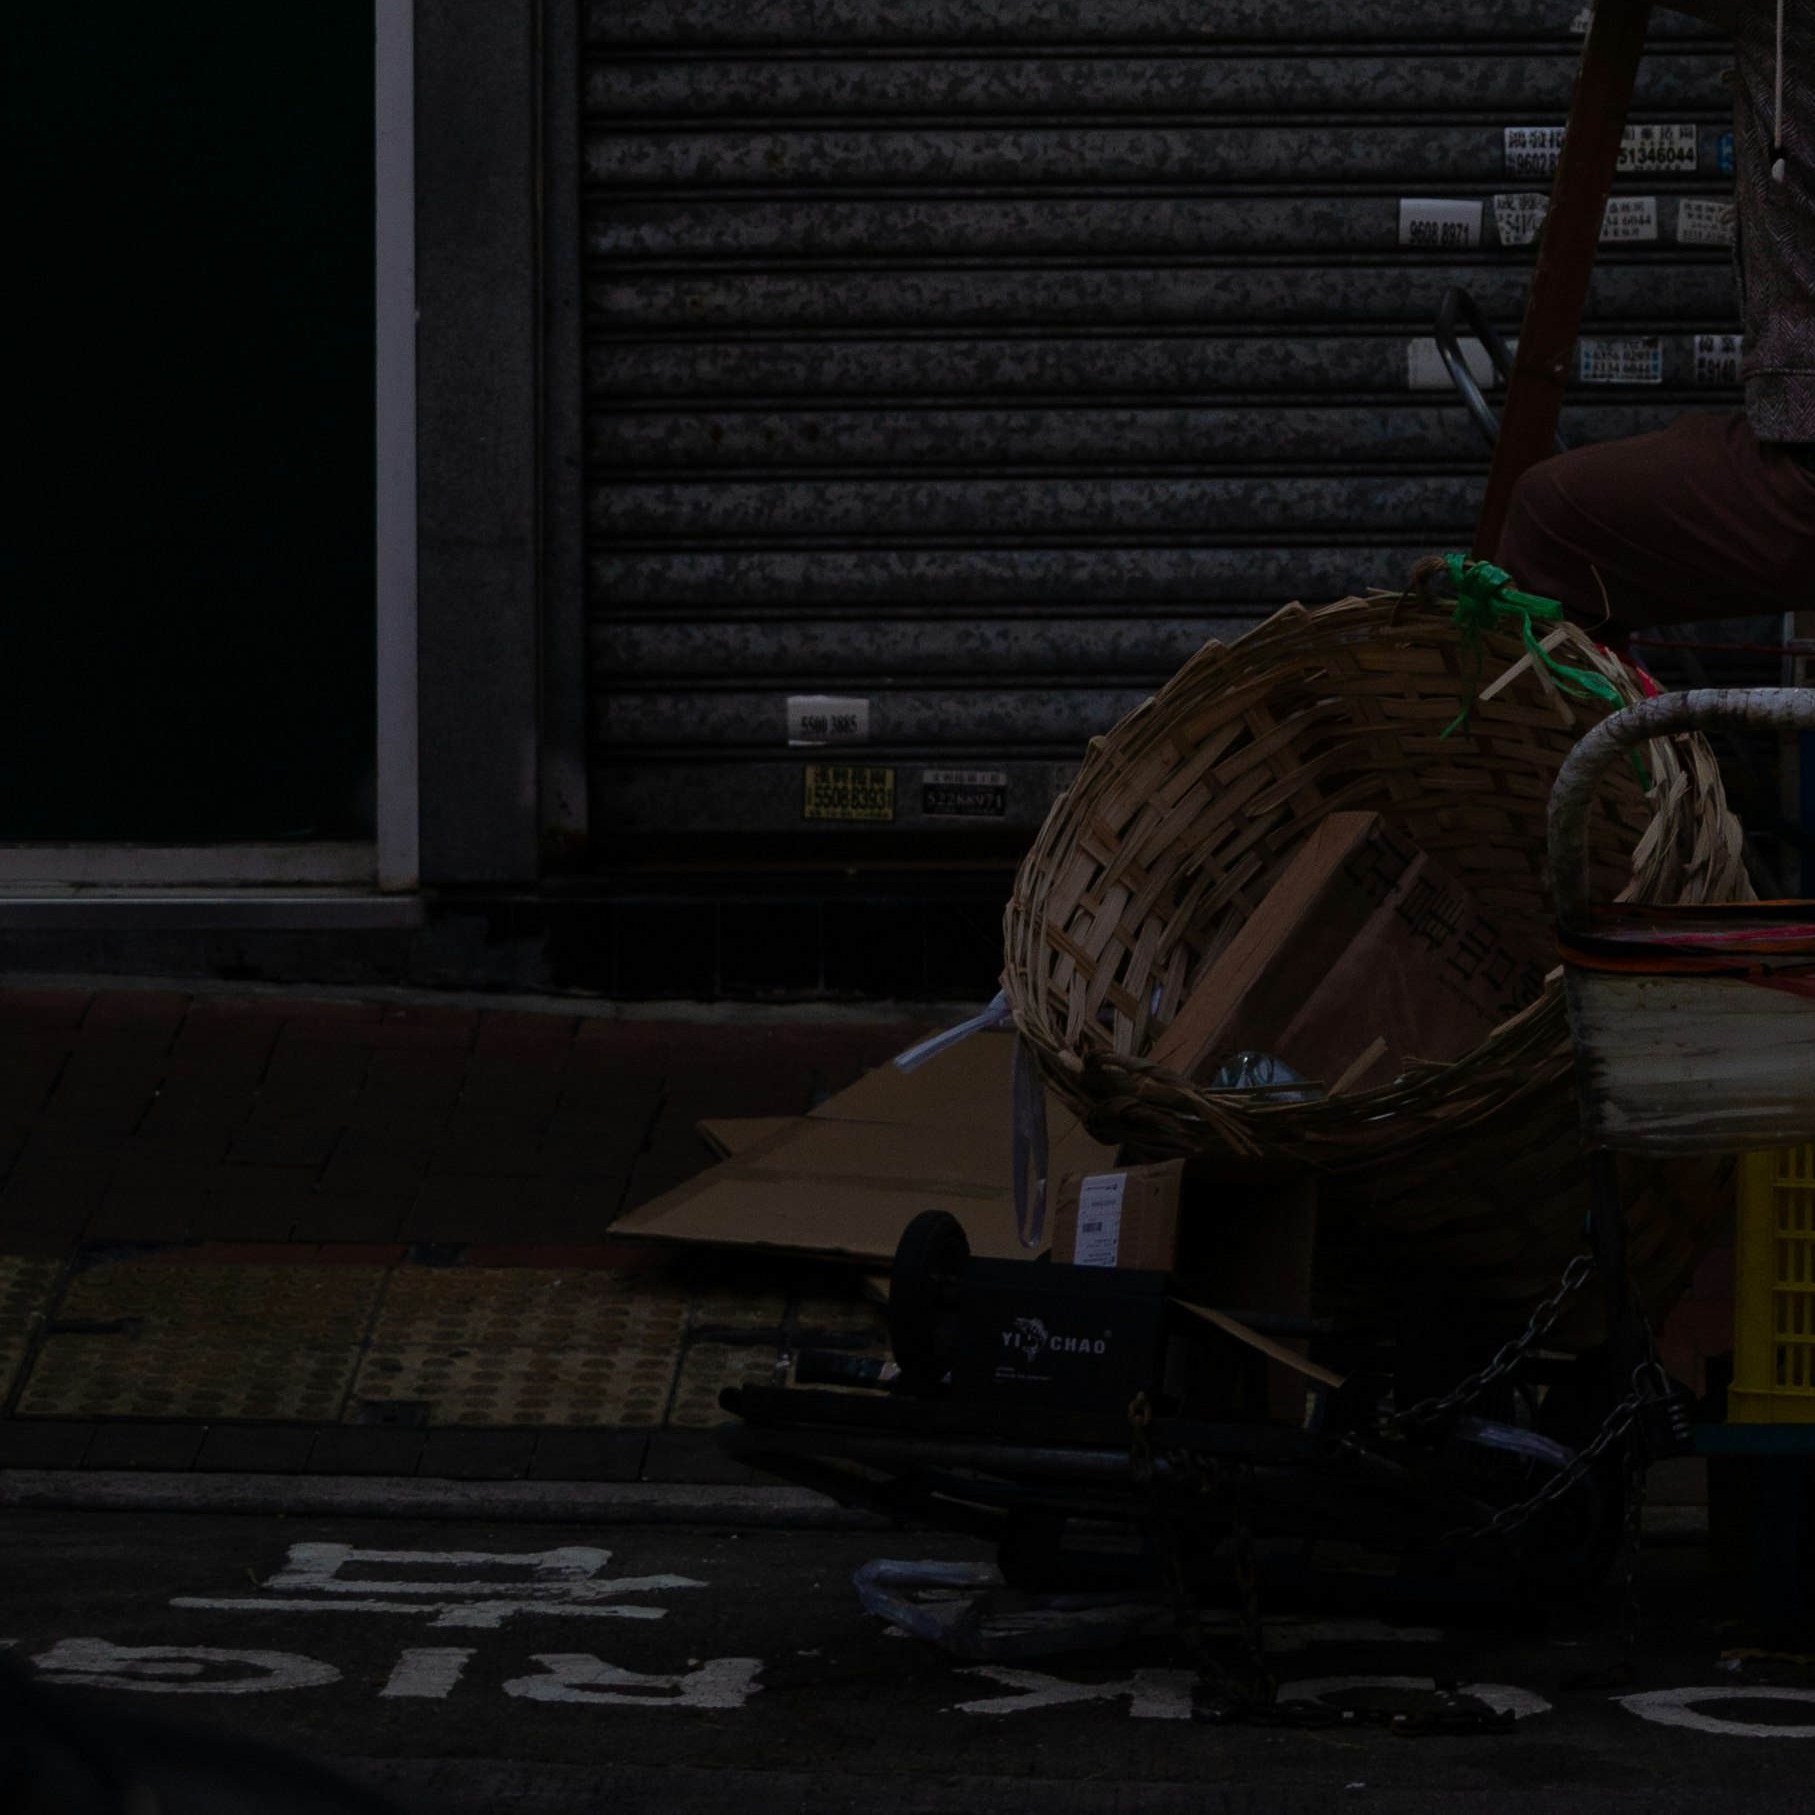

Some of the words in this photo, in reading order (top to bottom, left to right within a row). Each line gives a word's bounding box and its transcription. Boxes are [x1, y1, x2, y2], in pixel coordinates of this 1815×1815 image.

[1618, 147, 1695, 166] 51346044
[1001, 1331, 1021, 1347] YI
[1049, 1335, 1107, 1354] CHAO
